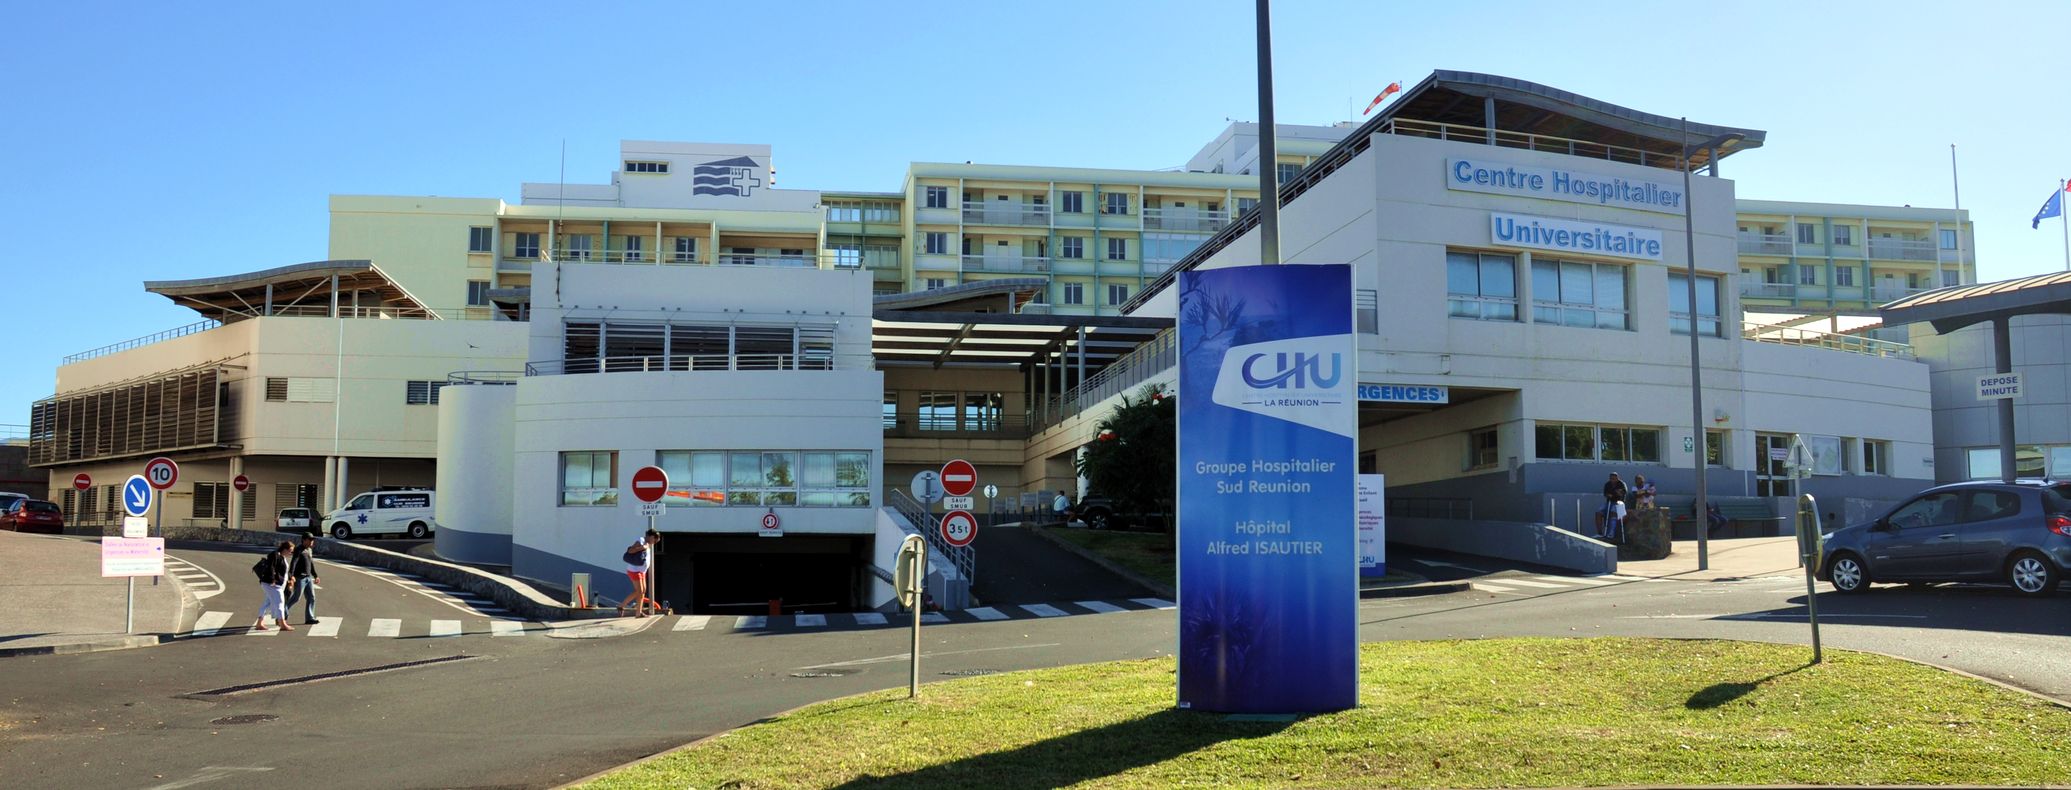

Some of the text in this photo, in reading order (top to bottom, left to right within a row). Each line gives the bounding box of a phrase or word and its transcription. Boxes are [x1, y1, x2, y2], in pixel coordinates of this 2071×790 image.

[1454, 160, 1682, 207] Centre Hospitalier
[1495, 216, 1661, 255] Universitaire
[1241, 352, 1341, 389] CHU
[1981, 376, 2018, 386] DEPOSE
[1358, 385, 1440, 401] RGENCES
[1981, 386, 2018, 396] MINUTE
[1278, 398, 1319, 407] RÉUNION
[152, 467, 170, 481] 10
[1195, 458, 1336, 476] Groupe Hospitalier
[1216, 479, 1311, 494] Sud Reunion
[1235, 520, 1291, 537] Hôpital
[1207, 541, 1323, 555] Alfred ISAUTIER
